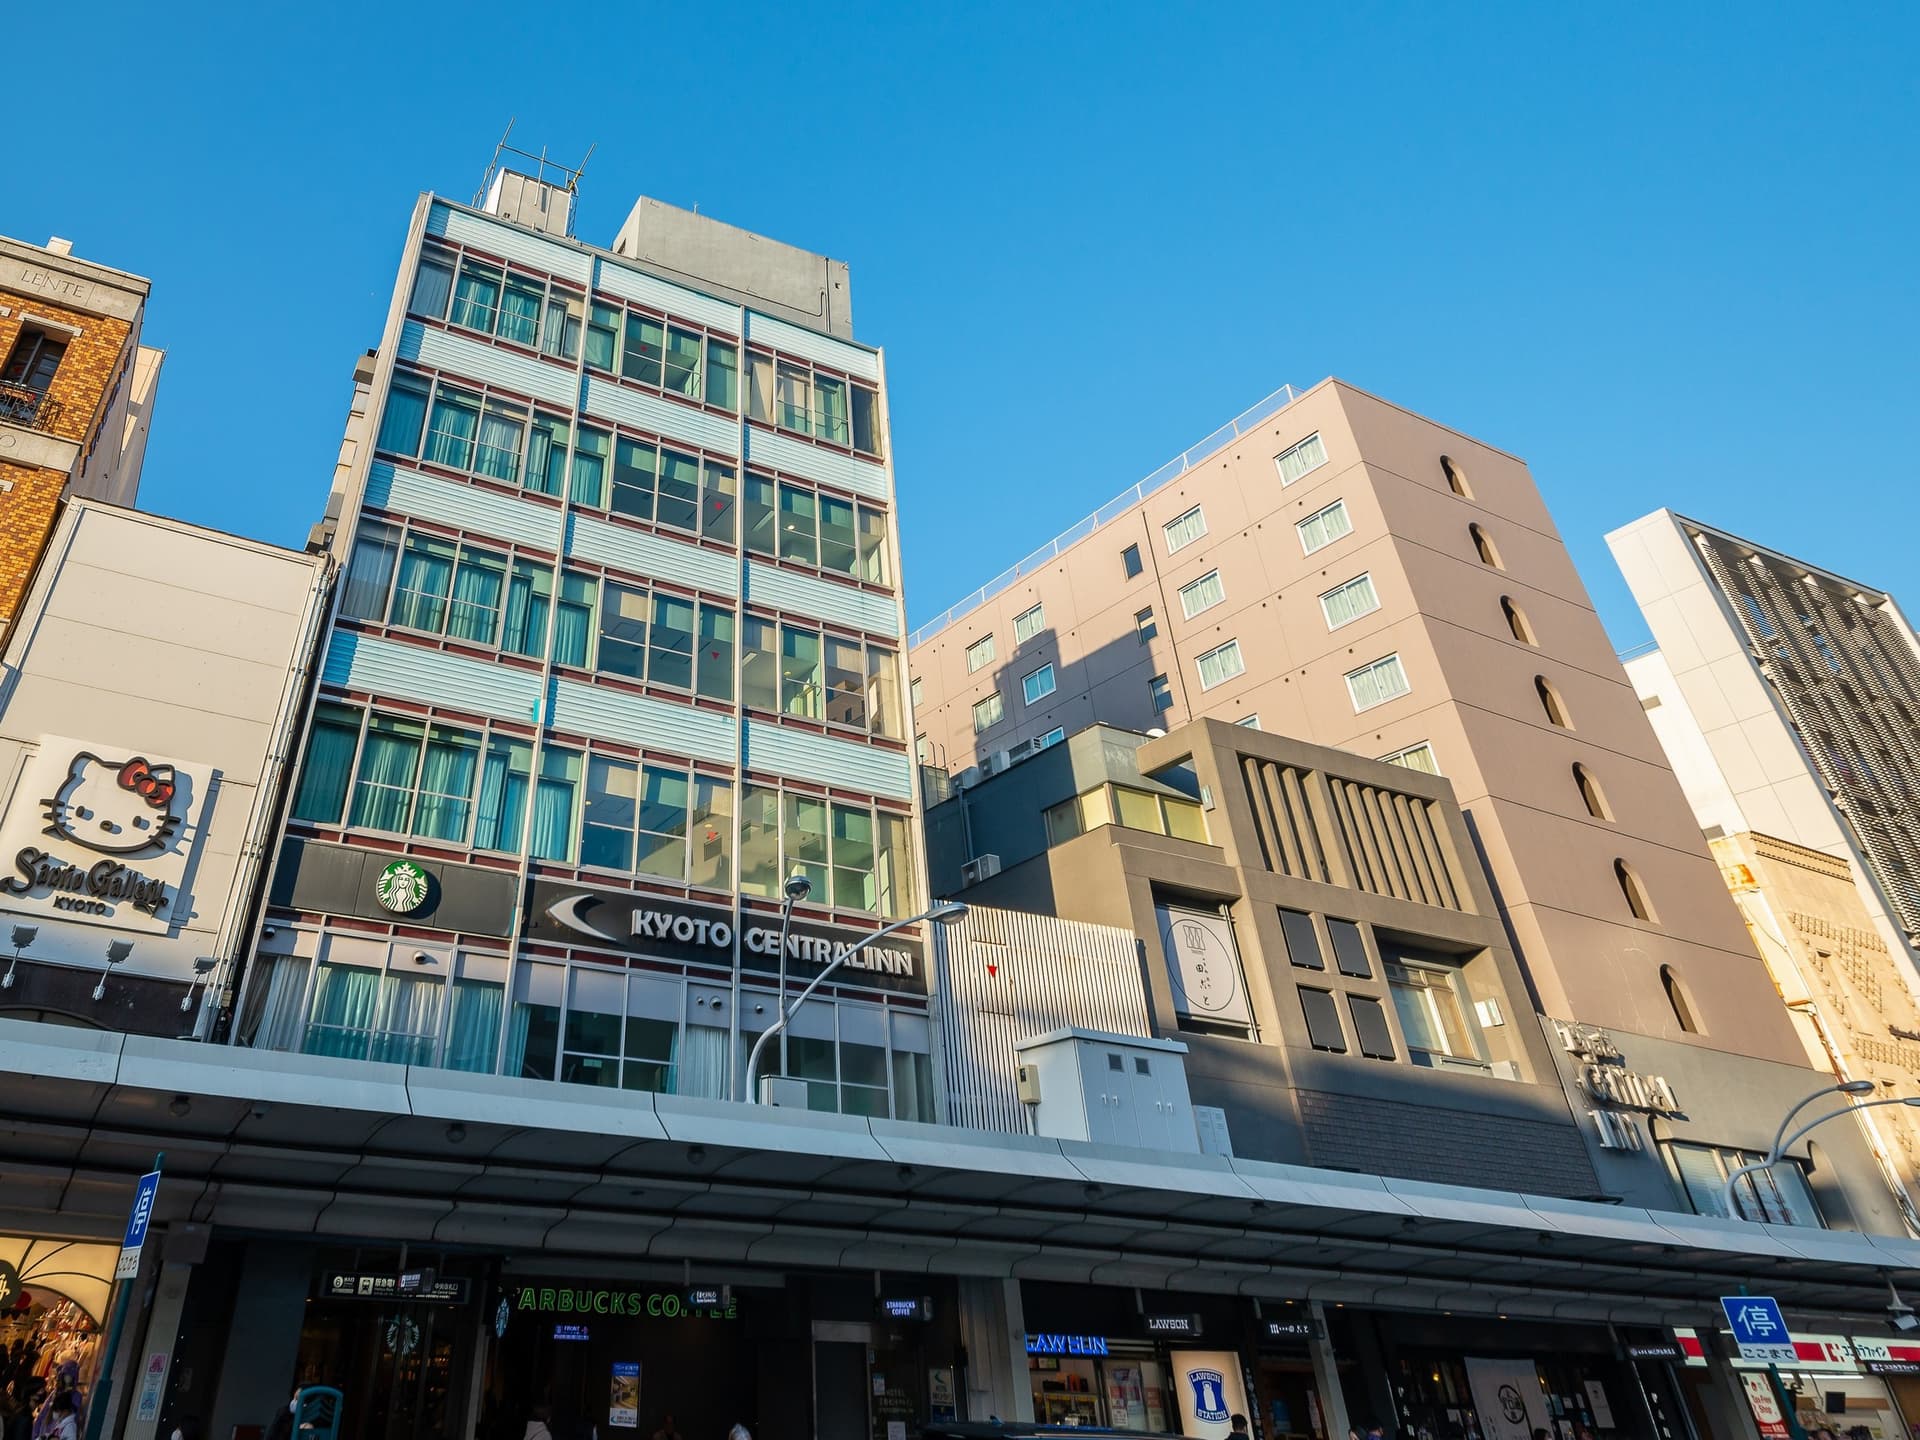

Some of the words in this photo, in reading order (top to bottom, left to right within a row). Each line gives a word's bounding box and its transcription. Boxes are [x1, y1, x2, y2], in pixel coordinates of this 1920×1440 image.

[21, 269, 85, 298] LENTE
[86, 859, 170, 919] Gallery
[53, 895, 107, 915] KYOTO
[631, 908, 731, 948] KYOTO
[745, 926, 865, 971] CENTRAL
[131, 1186, 152, 1235] 停
[517, 1287, 641, 1316] ARBUCKS
[886, 1300, 915, 1309] STARBUCKS
[891, 1308, 910, 1316] COFFEE
[1737, 1304, 1778, 1337] 停
[1149, 1318, 1189, 1330] LAWSON
[1743, 1347, 1795, 1359] ここまで
[1190, 1371, 1222, 1383] LAWSON
[1197, 1407, 1229, 1422] STATION
